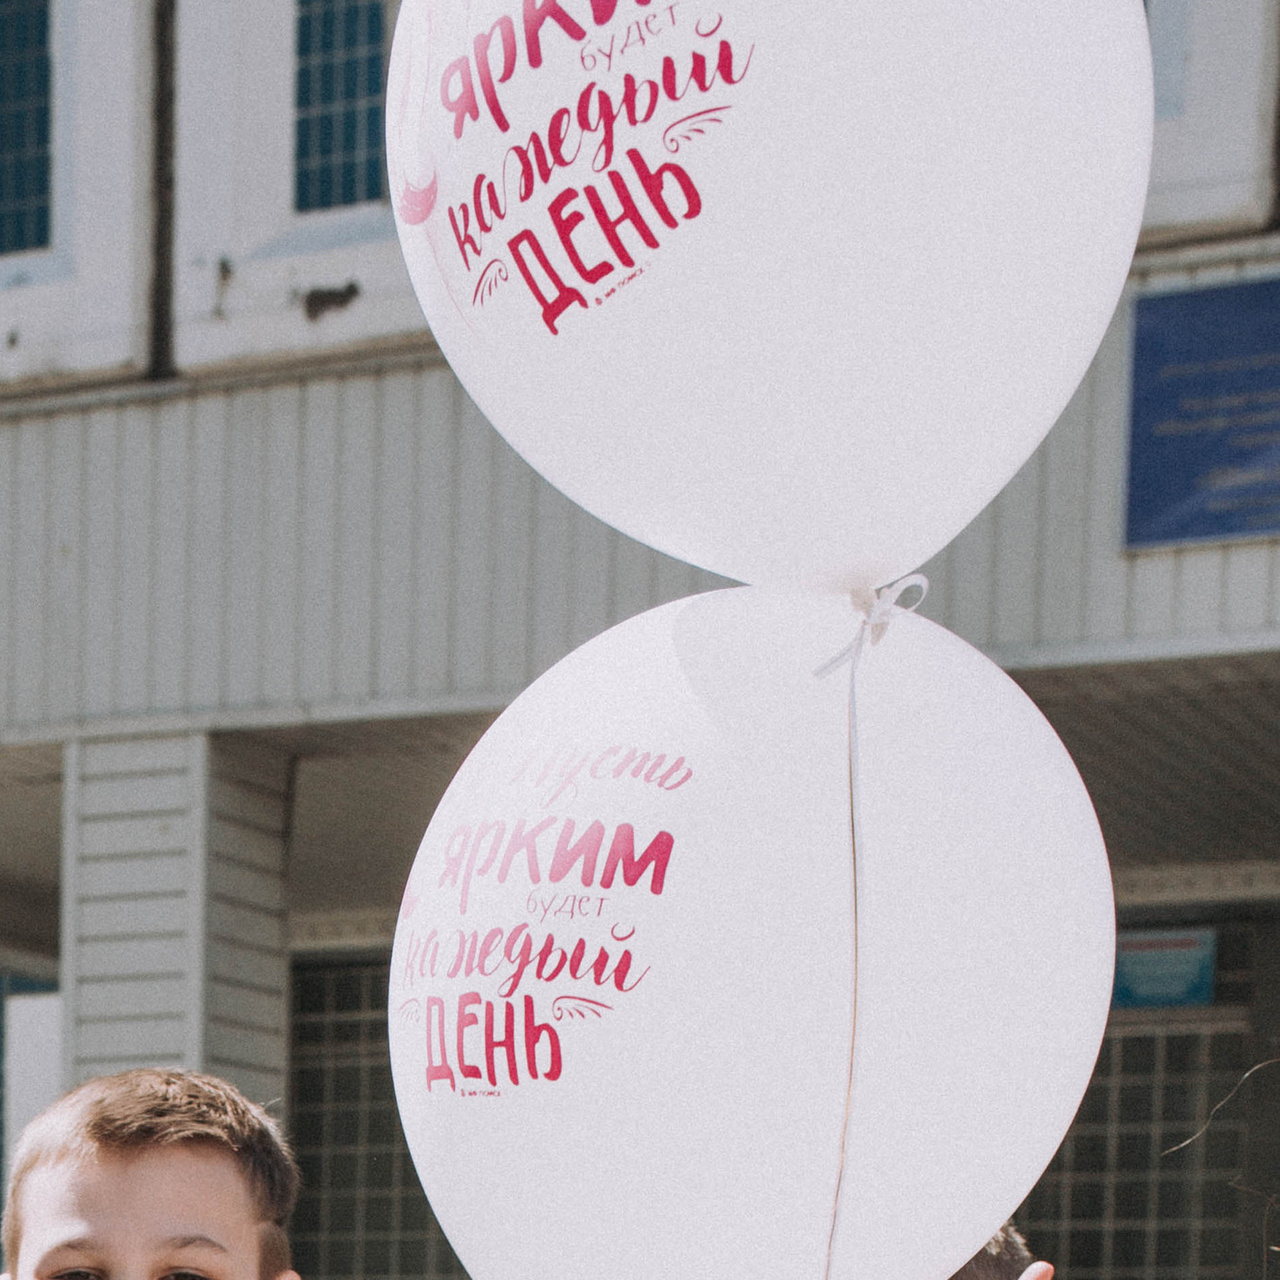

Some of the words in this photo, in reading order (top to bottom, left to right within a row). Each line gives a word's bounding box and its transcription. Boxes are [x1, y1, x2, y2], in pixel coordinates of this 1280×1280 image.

[447, 14, 755, 271] каждый
[507, 148, 702, 336] ДЕНЬ
[426, 991, 563, 1093] ДЕНЬ
